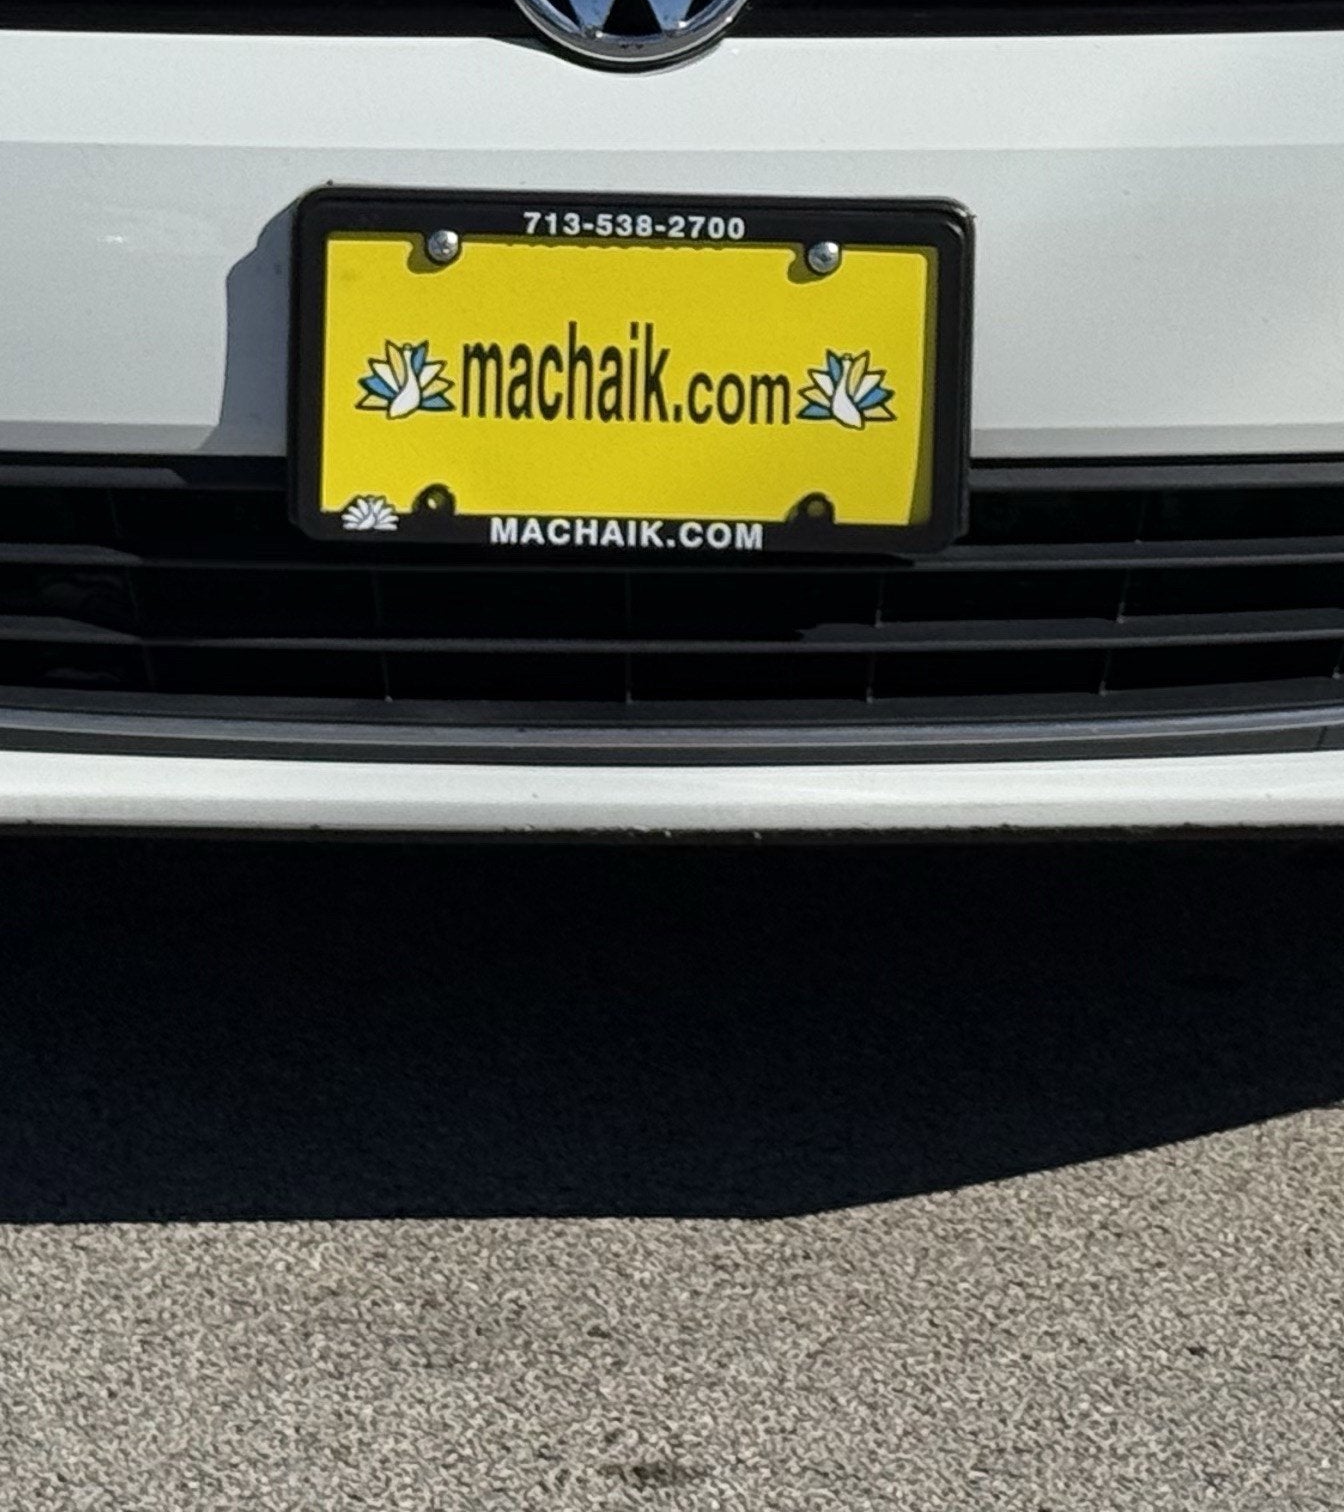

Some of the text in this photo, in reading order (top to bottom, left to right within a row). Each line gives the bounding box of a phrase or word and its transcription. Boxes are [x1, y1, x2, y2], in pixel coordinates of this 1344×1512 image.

[522, 211, 746, 240] 713-538-2700
[461, 320, 791, 425] machaik.com
[489, 517, 763, 550] MACHAIK.COM
